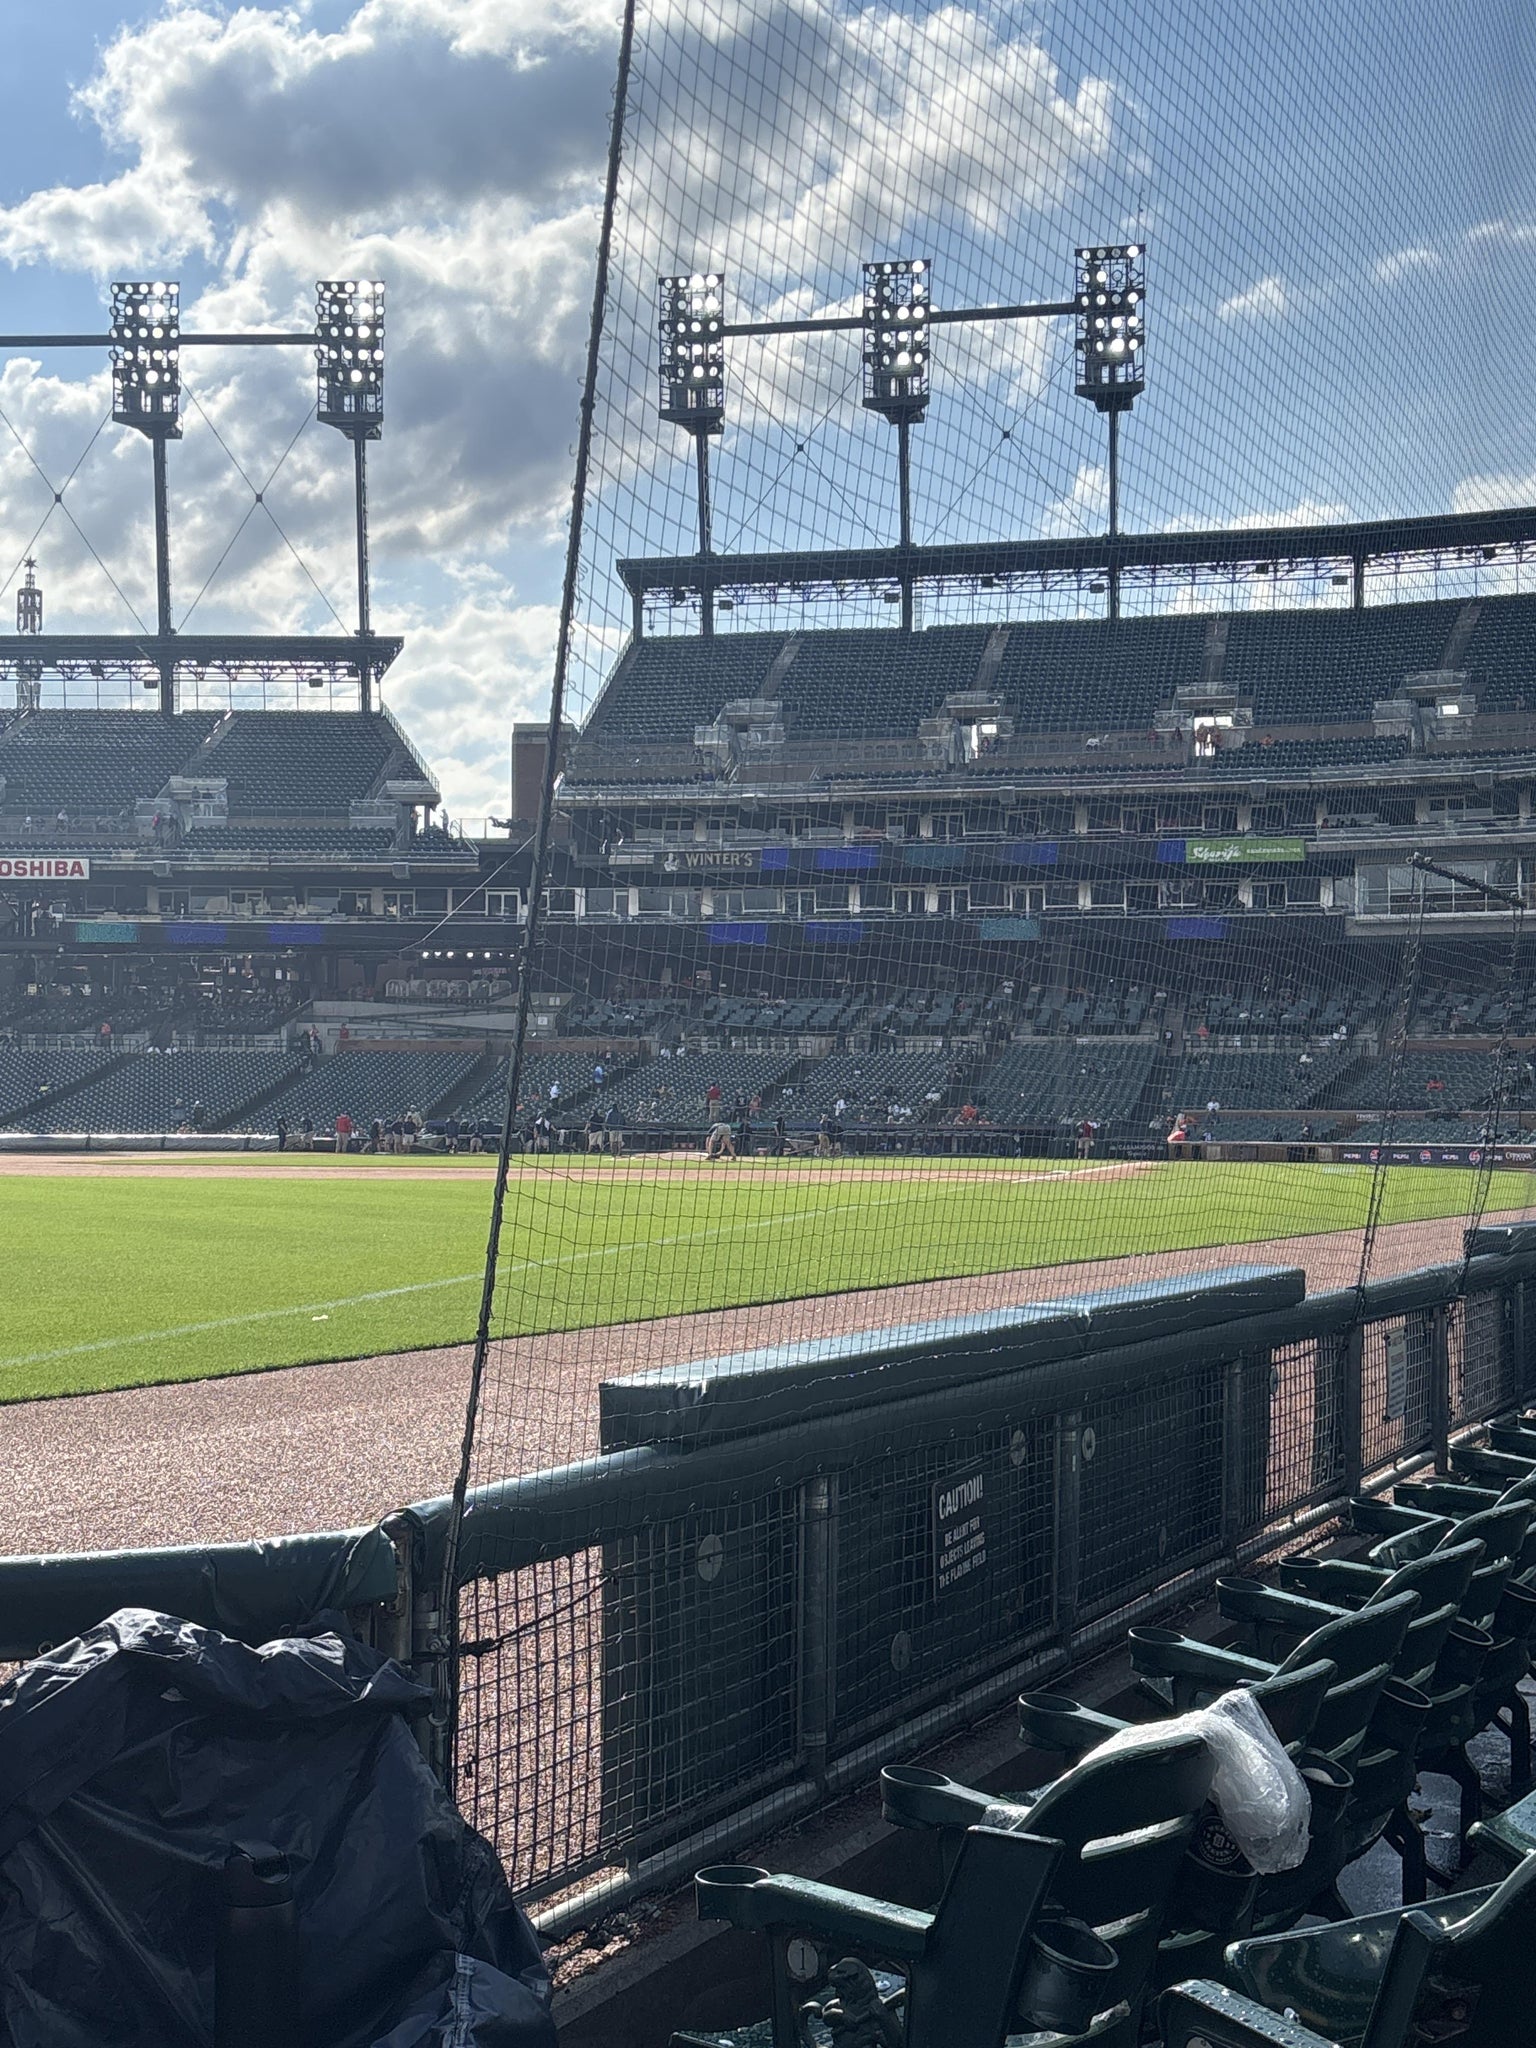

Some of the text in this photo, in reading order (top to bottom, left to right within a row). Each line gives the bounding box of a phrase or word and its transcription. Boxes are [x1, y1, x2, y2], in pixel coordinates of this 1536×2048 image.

[0, 860, 85, 877] OSHIBA
[685, 852, 753, 867] WINTER'S
[939, 1474, 983, 1520] CAUTION!
[940, 1544, 964, 1569] OBJECTS
[939, 1571, 950, 1589] THE
